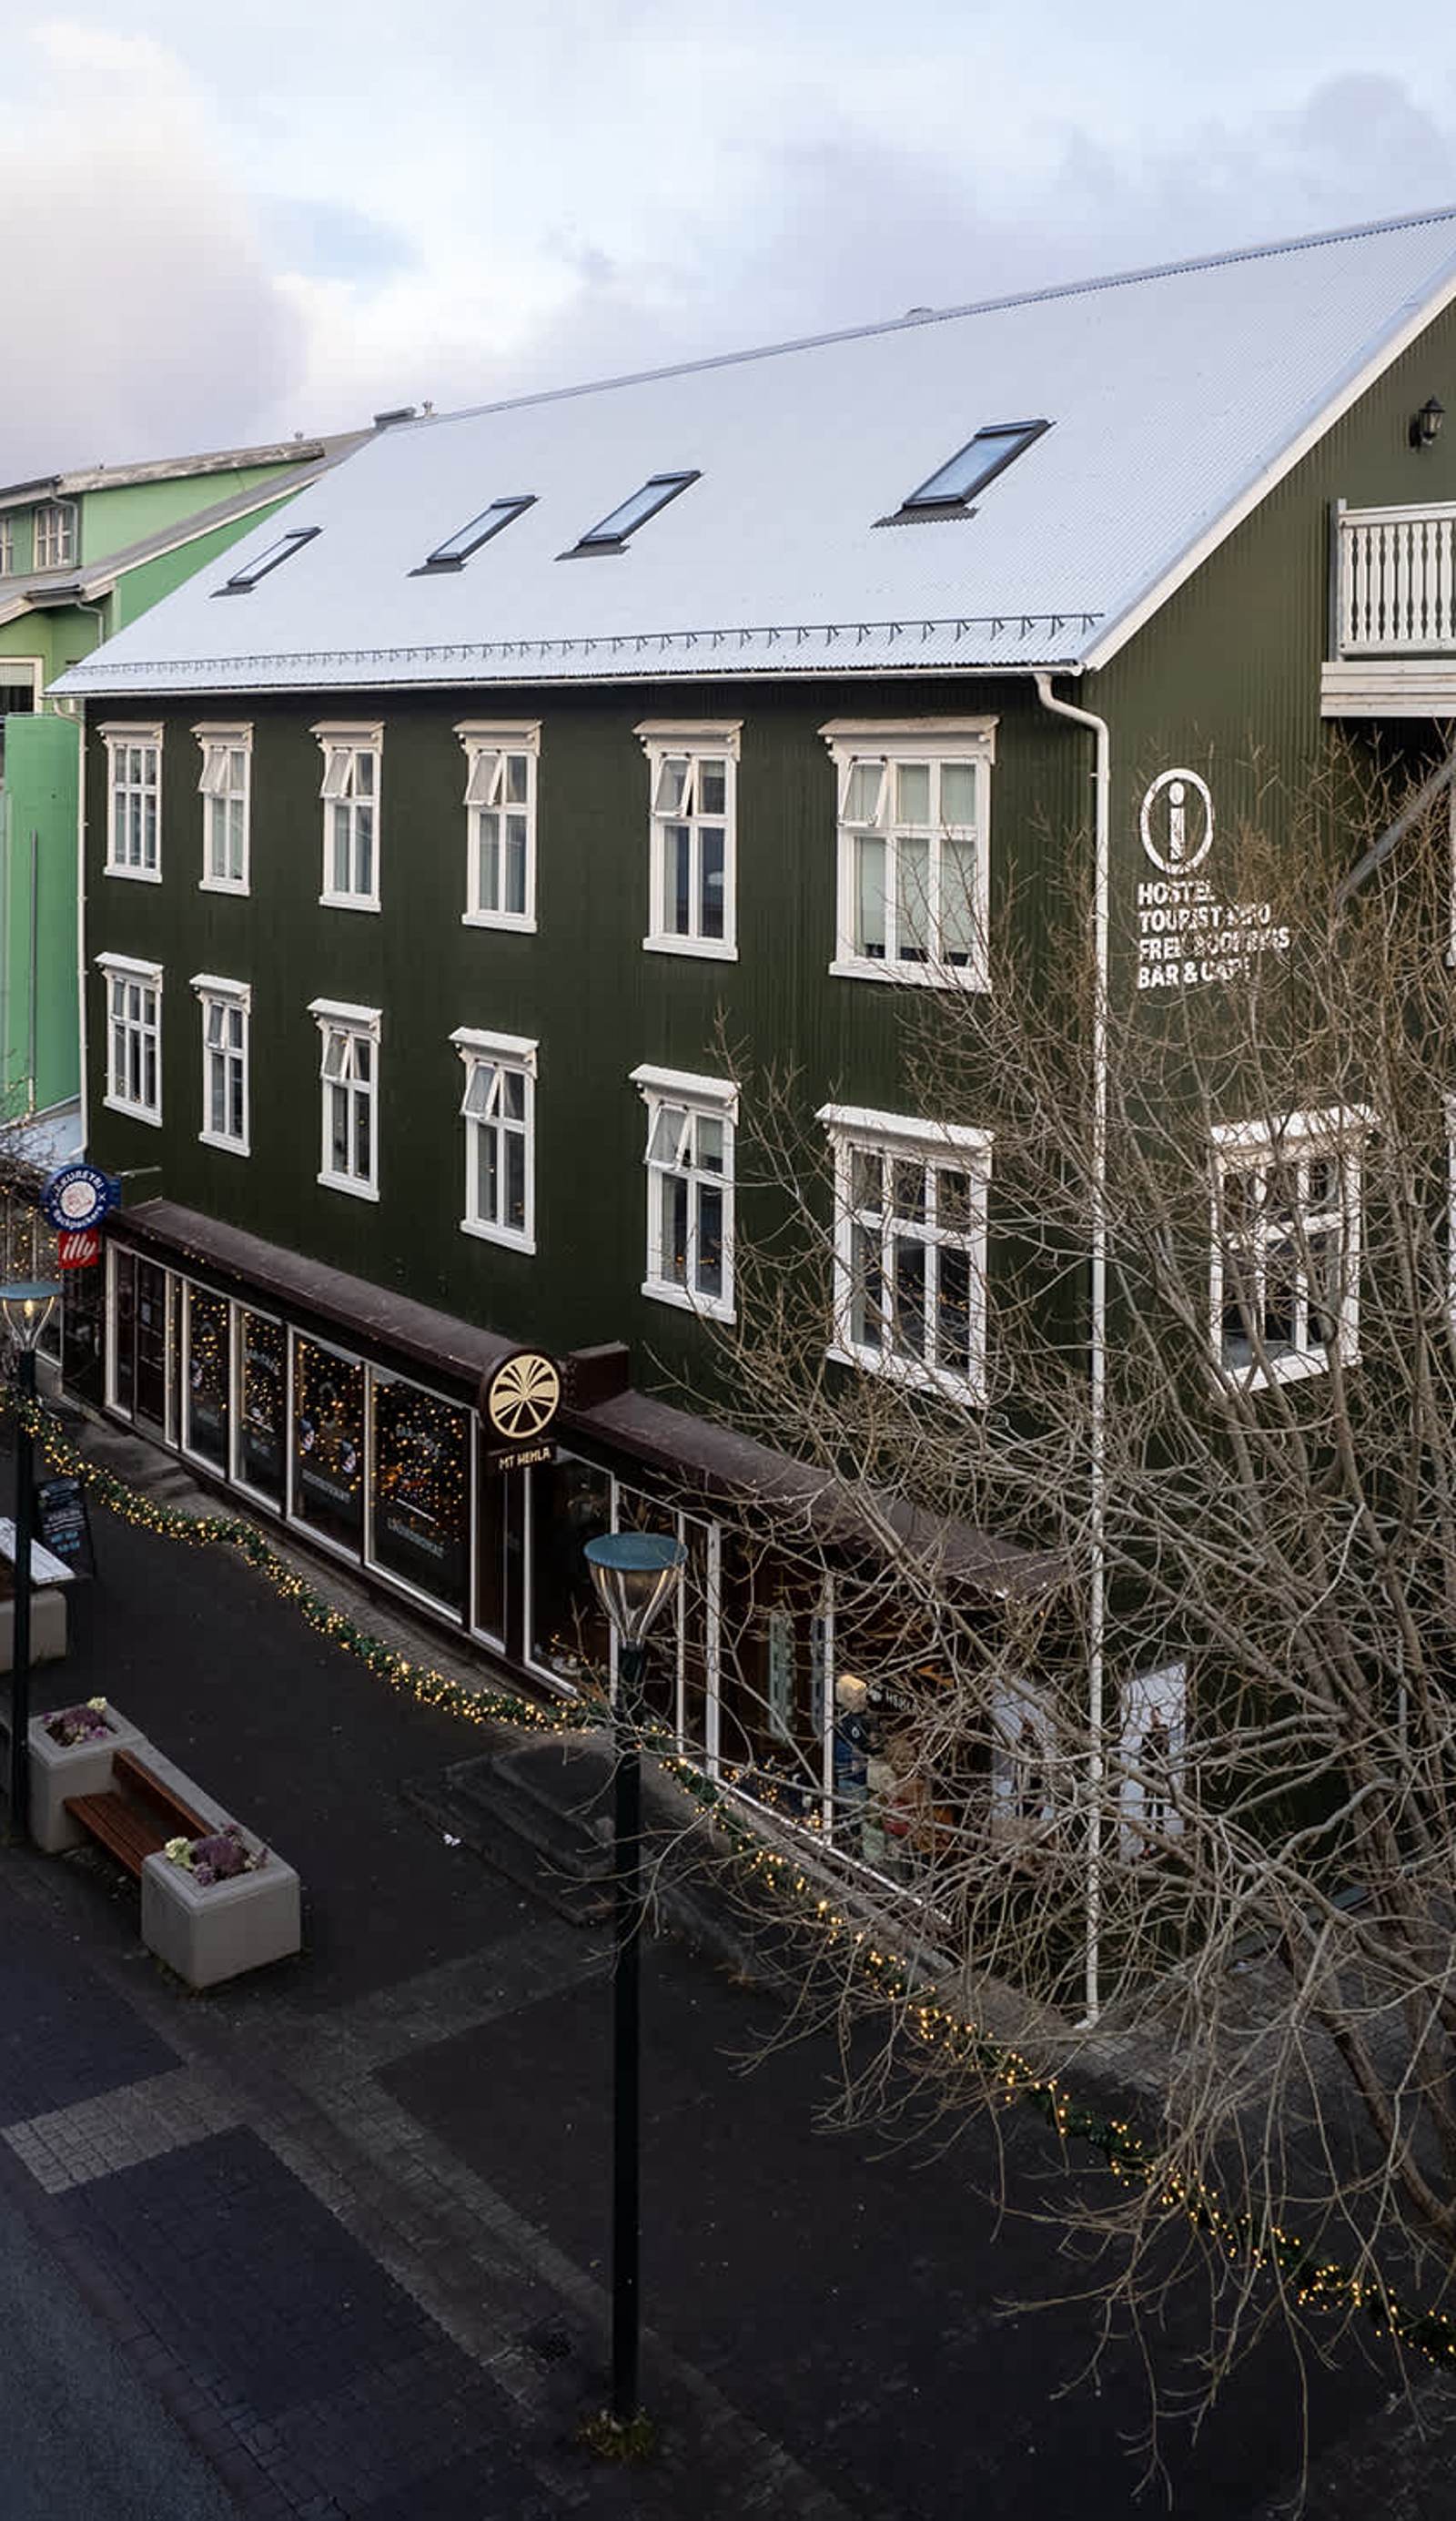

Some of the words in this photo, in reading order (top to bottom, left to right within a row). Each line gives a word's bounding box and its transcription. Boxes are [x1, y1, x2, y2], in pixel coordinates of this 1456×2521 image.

[1138, 880, 1216, 906] HOSTEL
[1139, 906, 1222, 933] TOURIST
[1138, 964, 1179, 989] BAR
[1184, 961, 1198, 984] &
[63, 1233, 96, 1265] illy
[499, 1454, 516, 1471] MT
